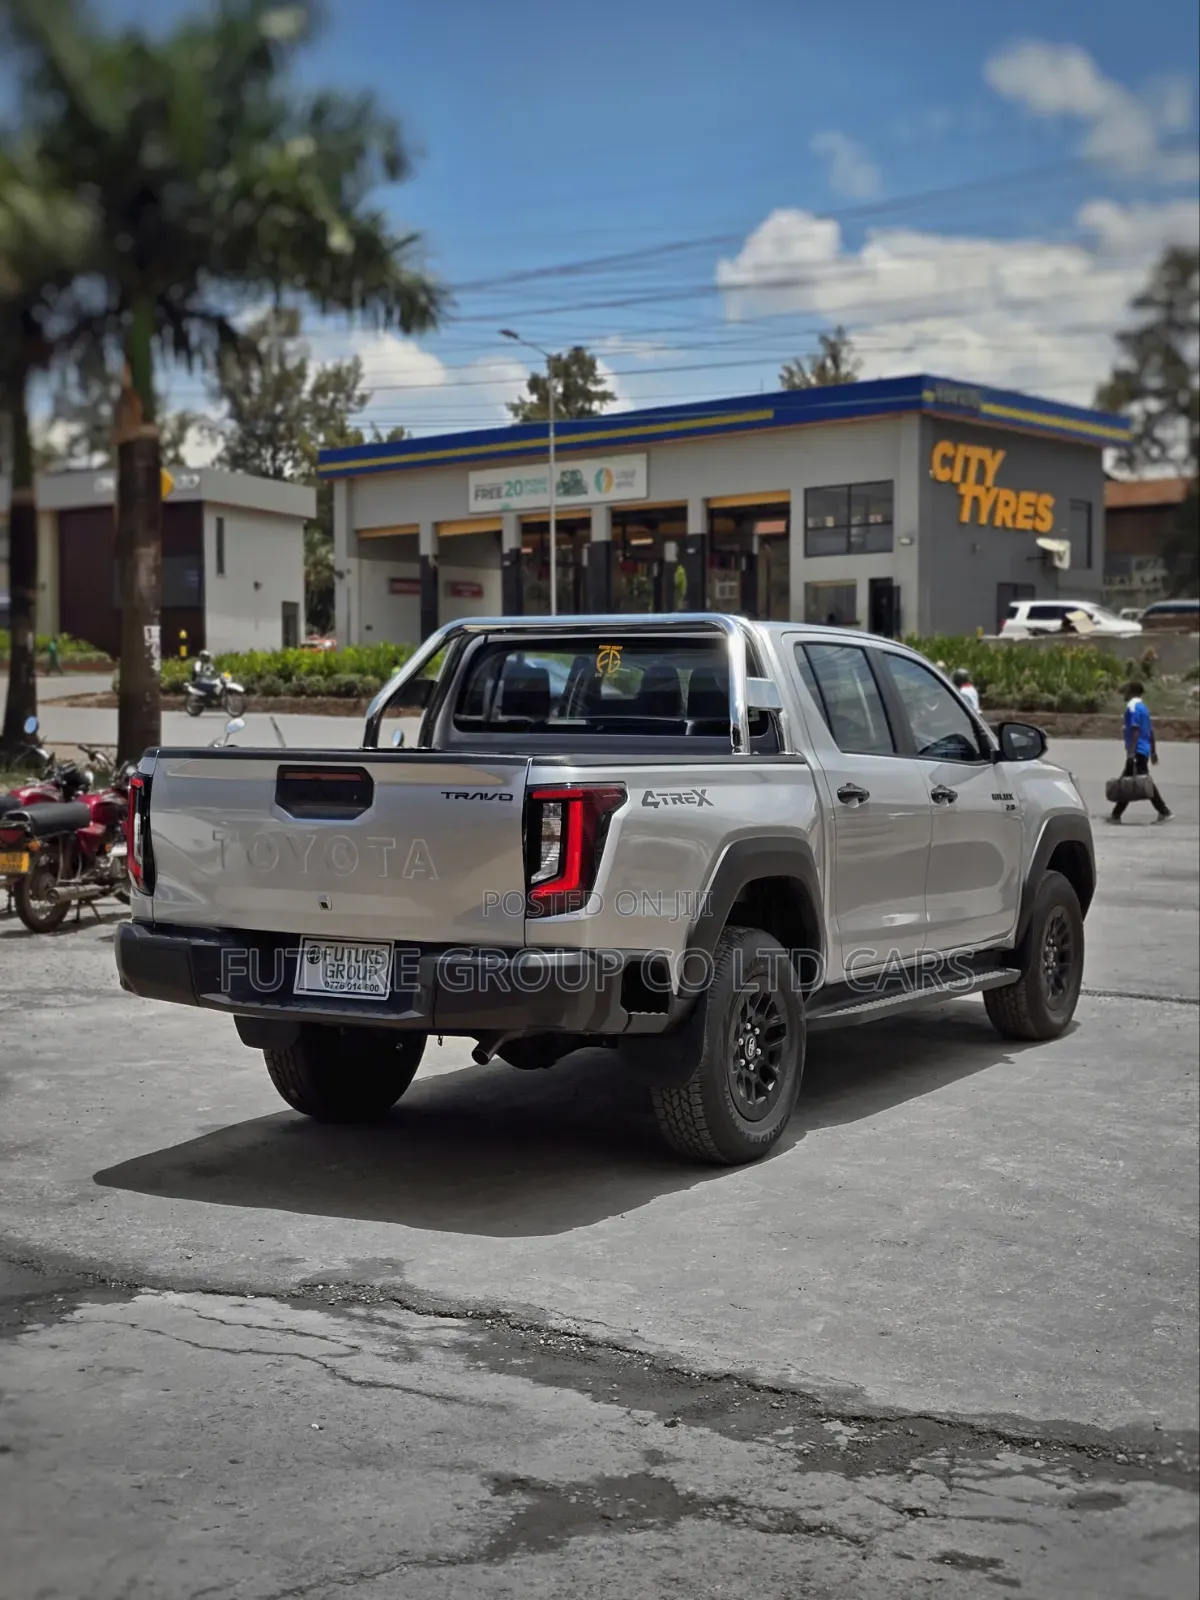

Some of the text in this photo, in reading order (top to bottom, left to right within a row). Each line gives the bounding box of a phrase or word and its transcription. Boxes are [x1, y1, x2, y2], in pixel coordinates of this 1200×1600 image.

[931, 440, 1006, 486] CITY
[474, 486, 504, 501] FREE
[504, 480, 523, 497] 20
[958, 484, 1056, 532] TYRES
[441, 791, 514, 801] TRAVO
[212, 830, 440, 880] TOYOTA
[323, 946, 385, 964] FUTURE
[325, 964, 377, 981] GROUP
